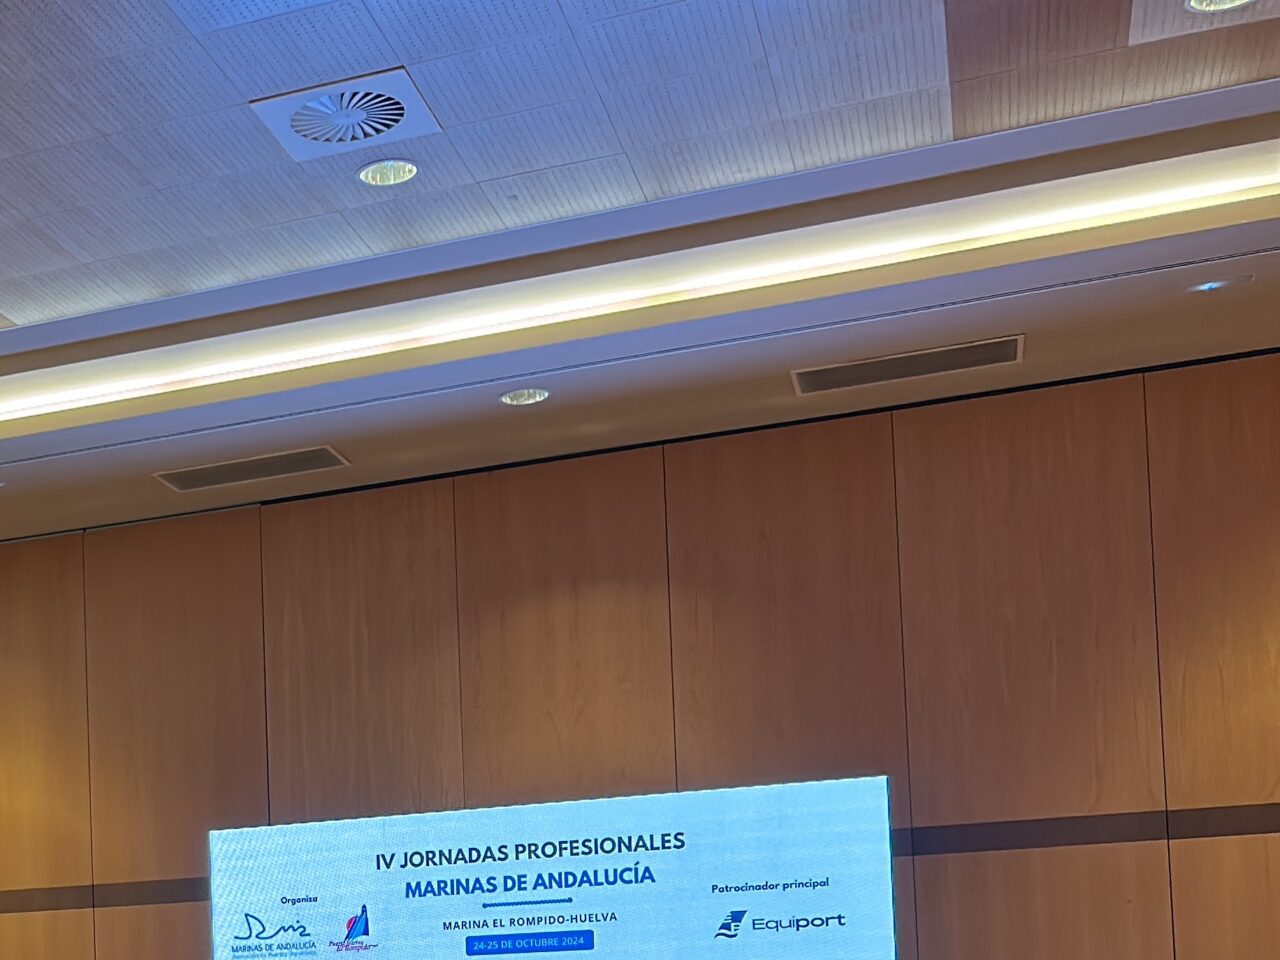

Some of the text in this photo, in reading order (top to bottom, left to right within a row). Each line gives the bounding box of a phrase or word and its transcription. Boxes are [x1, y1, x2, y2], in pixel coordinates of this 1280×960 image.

[375, 832, 685, 870] IV JORNADAS PROFESIONALES
[405, 862, 656, 898] MARINAS DE ANDALUCÍA
[711, 878, 829, 894] Patrocinador principal
[280, 895, 318, 905] Organiza
[443, 912, 617, 931] MARINA EL ROMPIDO-HUELVA
[752, 914, 846, 932] Equiport
[232, 944, 263, 953] MARINAS
[276, 940, 317, 950] ANDALUCÍA
[473, 936, 584, 950] 24-25 DE OCTUBRE 2024
